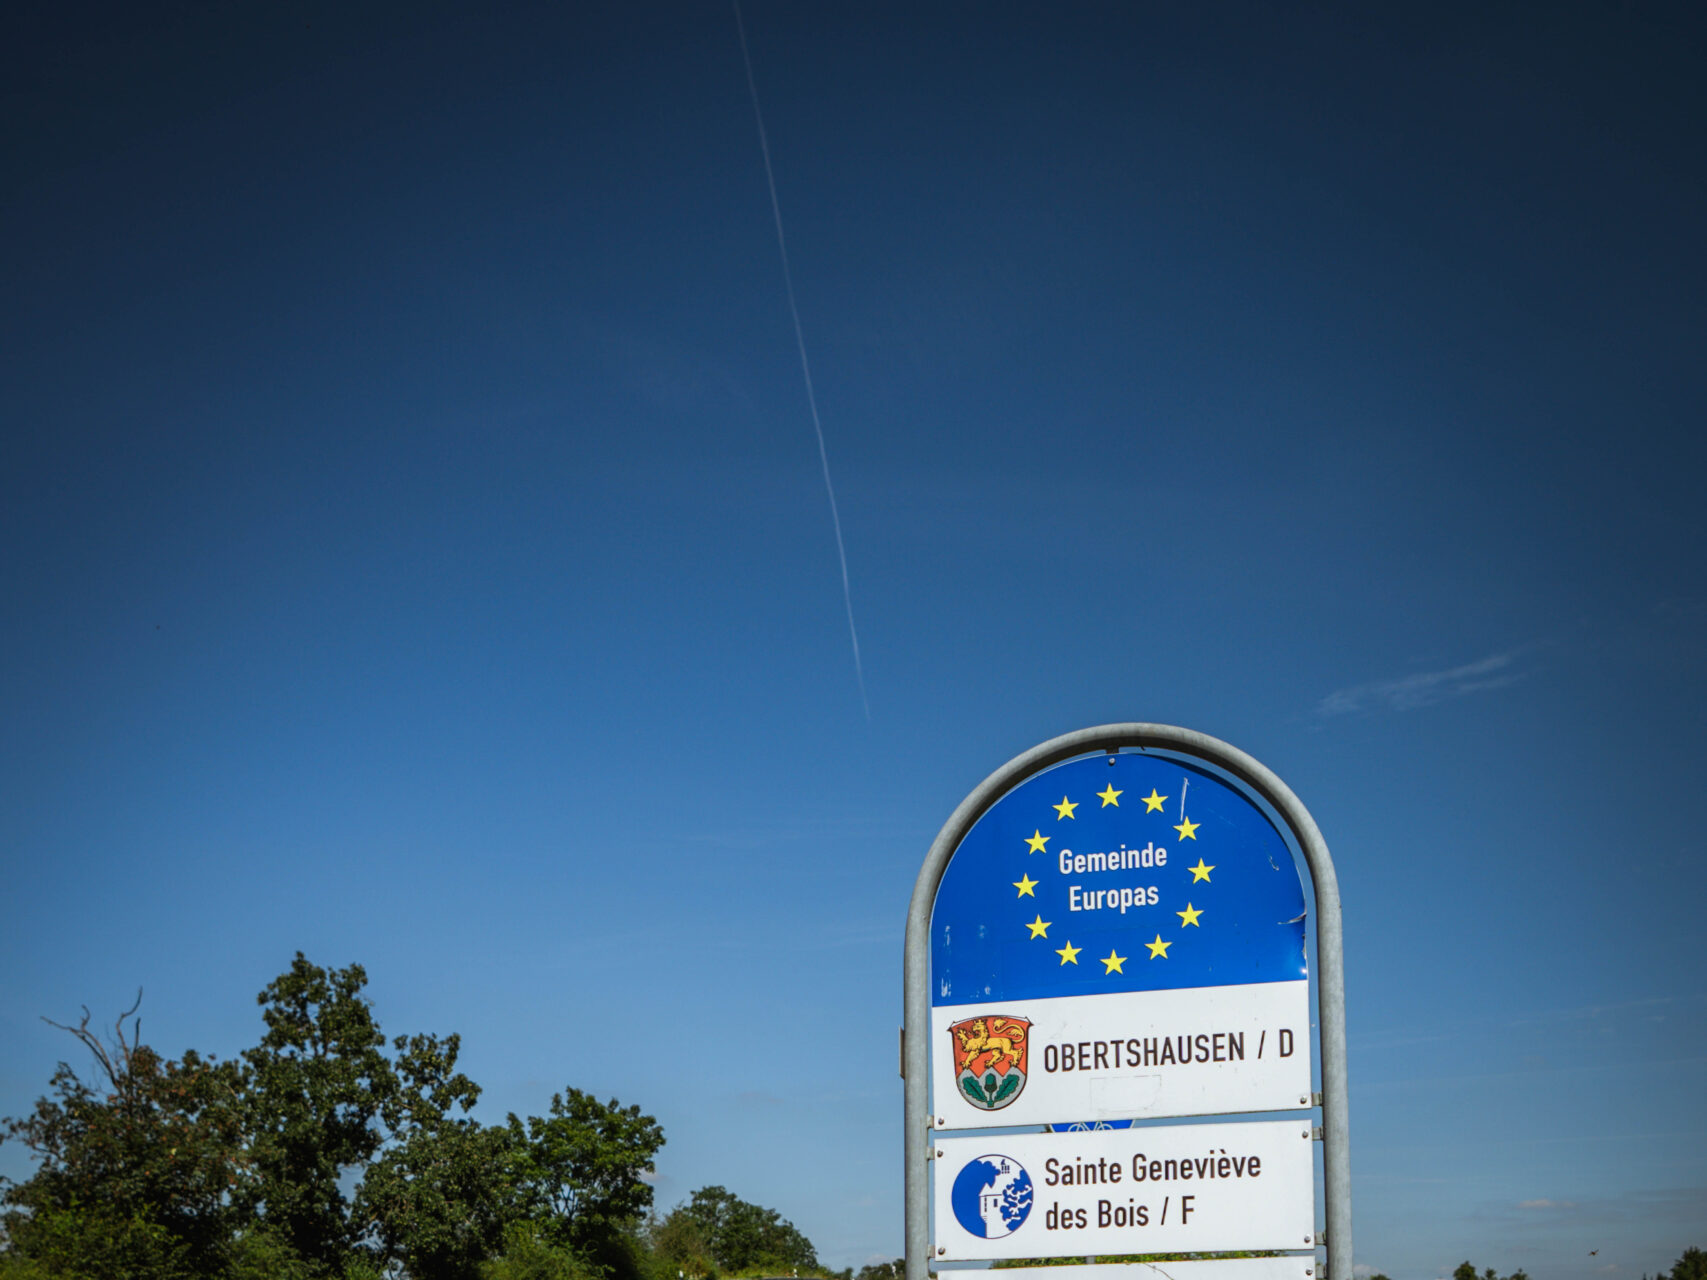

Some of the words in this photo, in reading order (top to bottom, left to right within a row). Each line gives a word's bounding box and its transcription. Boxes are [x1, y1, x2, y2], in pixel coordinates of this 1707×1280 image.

[1059, 841, 1167, 875] Gemeinde
[1069, 885, 1160, 914] Europas
[1044, 1031, 1245, 1073] OBERTSHAUSEN
[1257, 1030, 1266, 1060] /
[1279, 1028, 1294, 1058] D
[1045, 1156, 1122, 1187] Sainte
[1132, 1148, 1261, 1182] Geneviève
[1045, 1201, 1088, 1231] des
[1098, 1197, 1149, 1229] Bois
[1160, 1196, 1169, 1226] /
[1182, 1195, 1195, 1225] F
